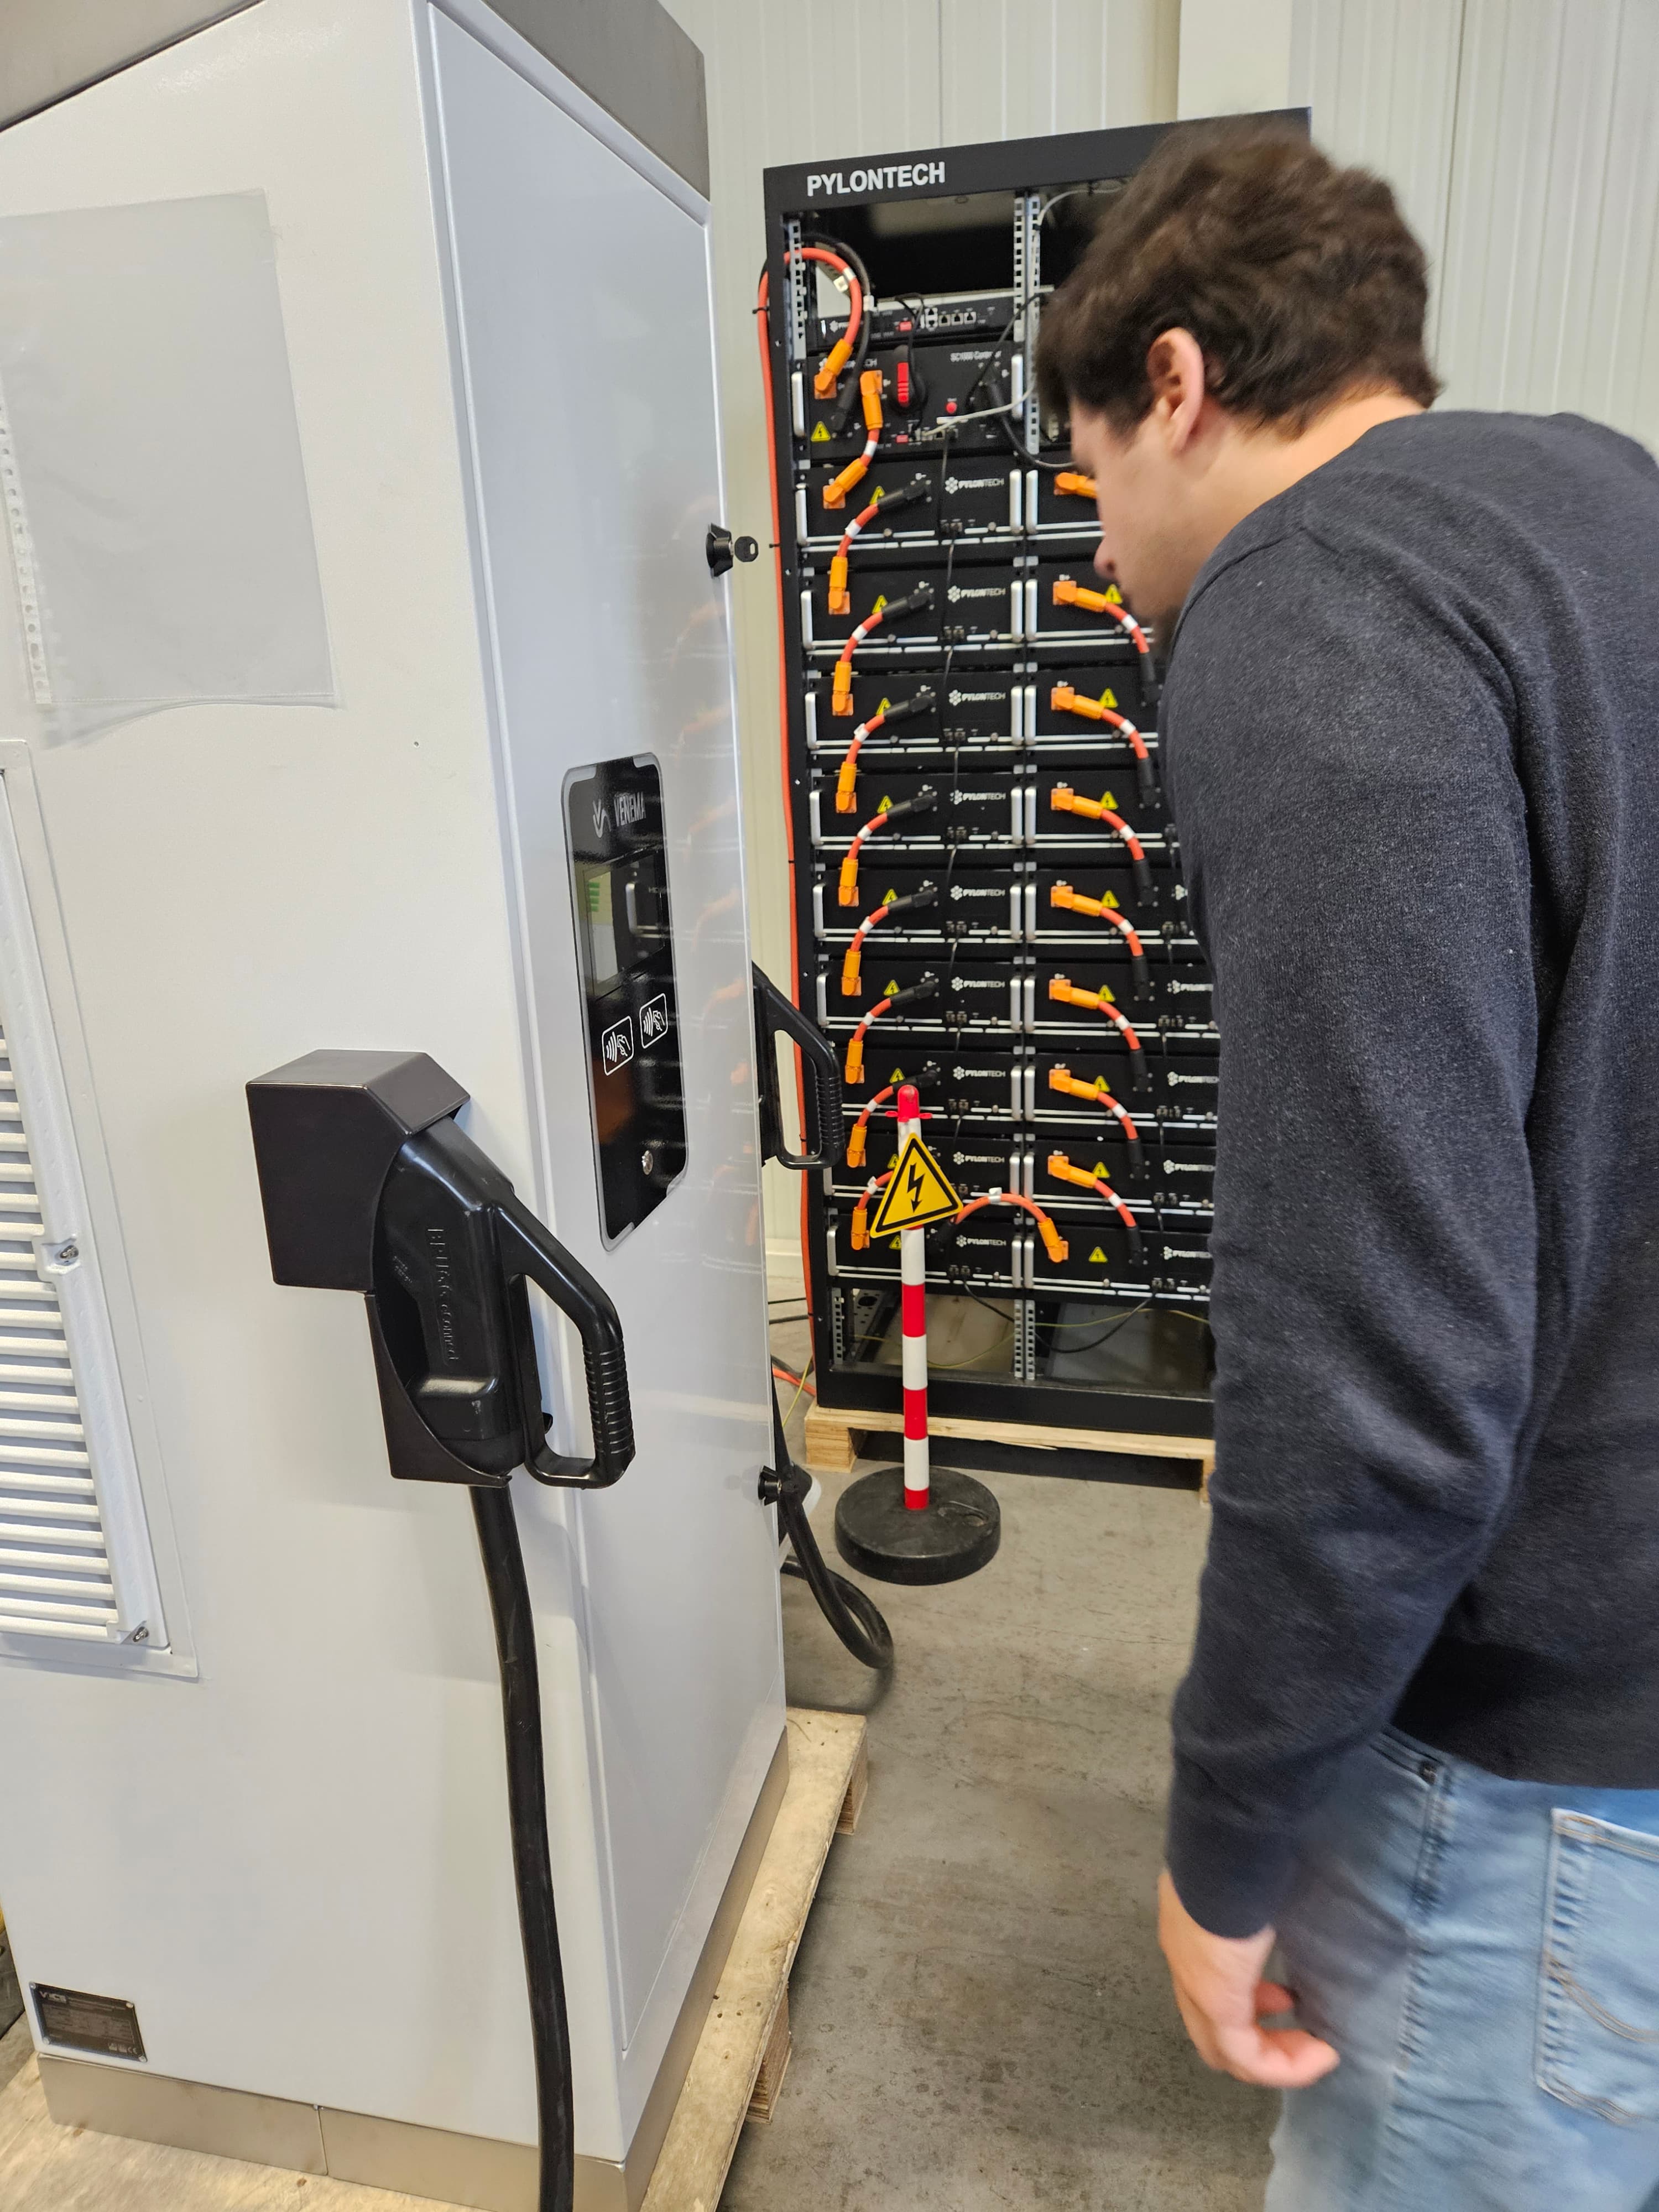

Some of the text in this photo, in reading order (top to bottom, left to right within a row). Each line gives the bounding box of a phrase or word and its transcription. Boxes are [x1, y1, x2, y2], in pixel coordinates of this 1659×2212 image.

[807, 161, 945, 197] PYLONTECH
[958, 478, 1004, 489] PYLONTECH
[961, 587, 1005, 599] PYLONTECH
[961, 692, 1005, 702] PYLONTECH
[963, 792, 1006, 801] PYLONTECH
[614, 791, 646, 827] VENEMA
[963, 889, 1005, 897] PYLONTECH
[964, 980, 1005, 988] PYLONTECH
[967, 1238, 1006, 1246] PYLONTECH
